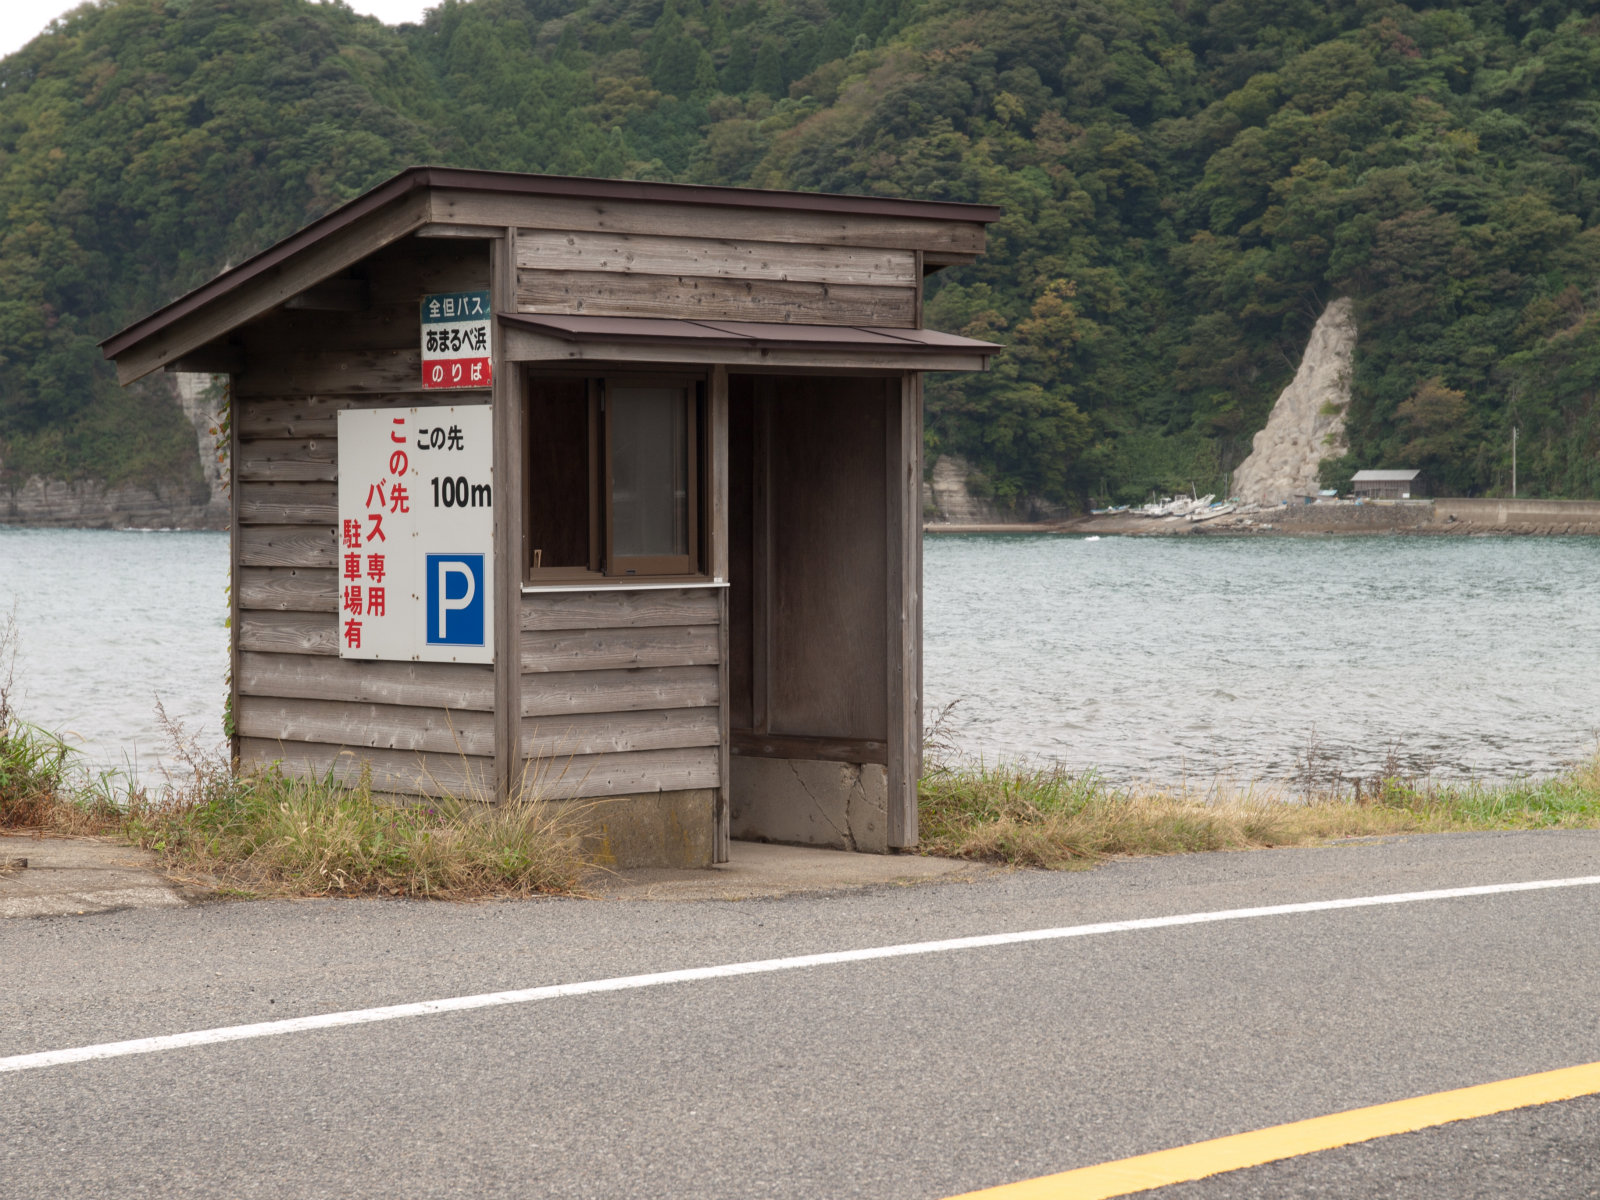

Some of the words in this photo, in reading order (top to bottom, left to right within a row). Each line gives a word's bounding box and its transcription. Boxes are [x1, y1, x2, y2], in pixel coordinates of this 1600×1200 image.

[429, 297, 483, 317] 全但バス
[427, 326, 486, 352] あまるべ浜
[432, 363, 482, 382] のりば
[417, 425, 464, 451] この先
[390, 417, 410, 514] この先
[431, 476, 492, 508] 100m
[343, 519, 362, 649] 駐車場有
[438, 561, 476, 639] P
